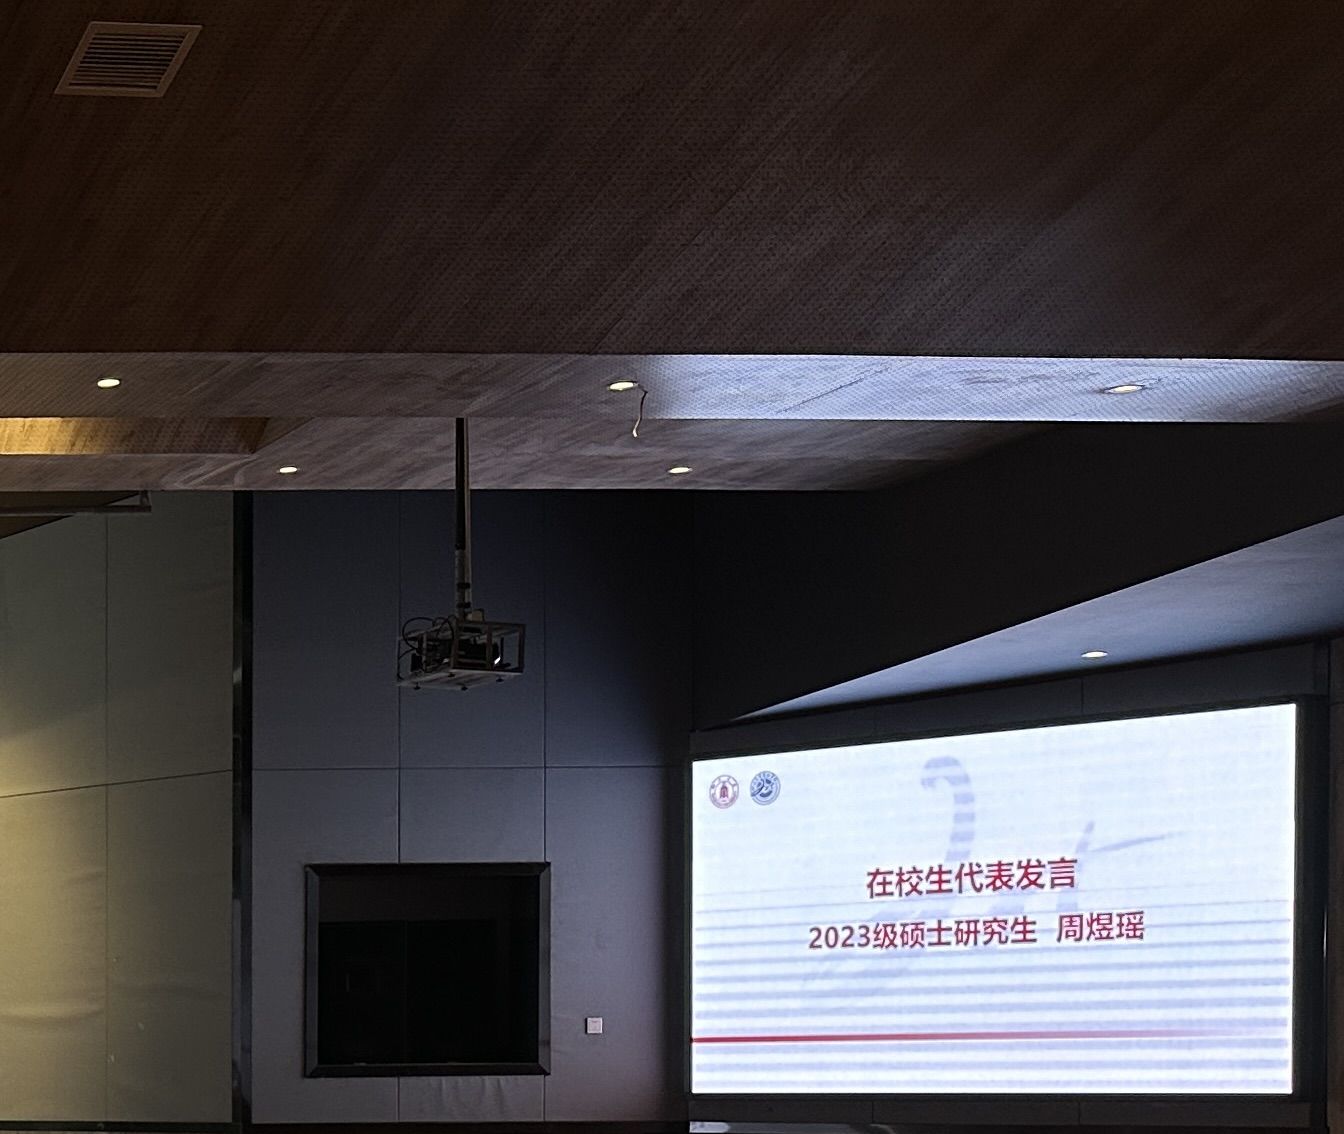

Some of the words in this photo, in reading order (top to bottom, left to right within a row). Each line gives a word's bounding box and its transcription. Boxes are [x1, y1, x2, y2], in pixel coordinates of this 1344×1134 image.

[866, 857, 1078, 899] 在校生代表发言
[809, 915, 1037, 950] 2023级硕士研究生
[1056, 910, 1145, 943] 周煜瑶
